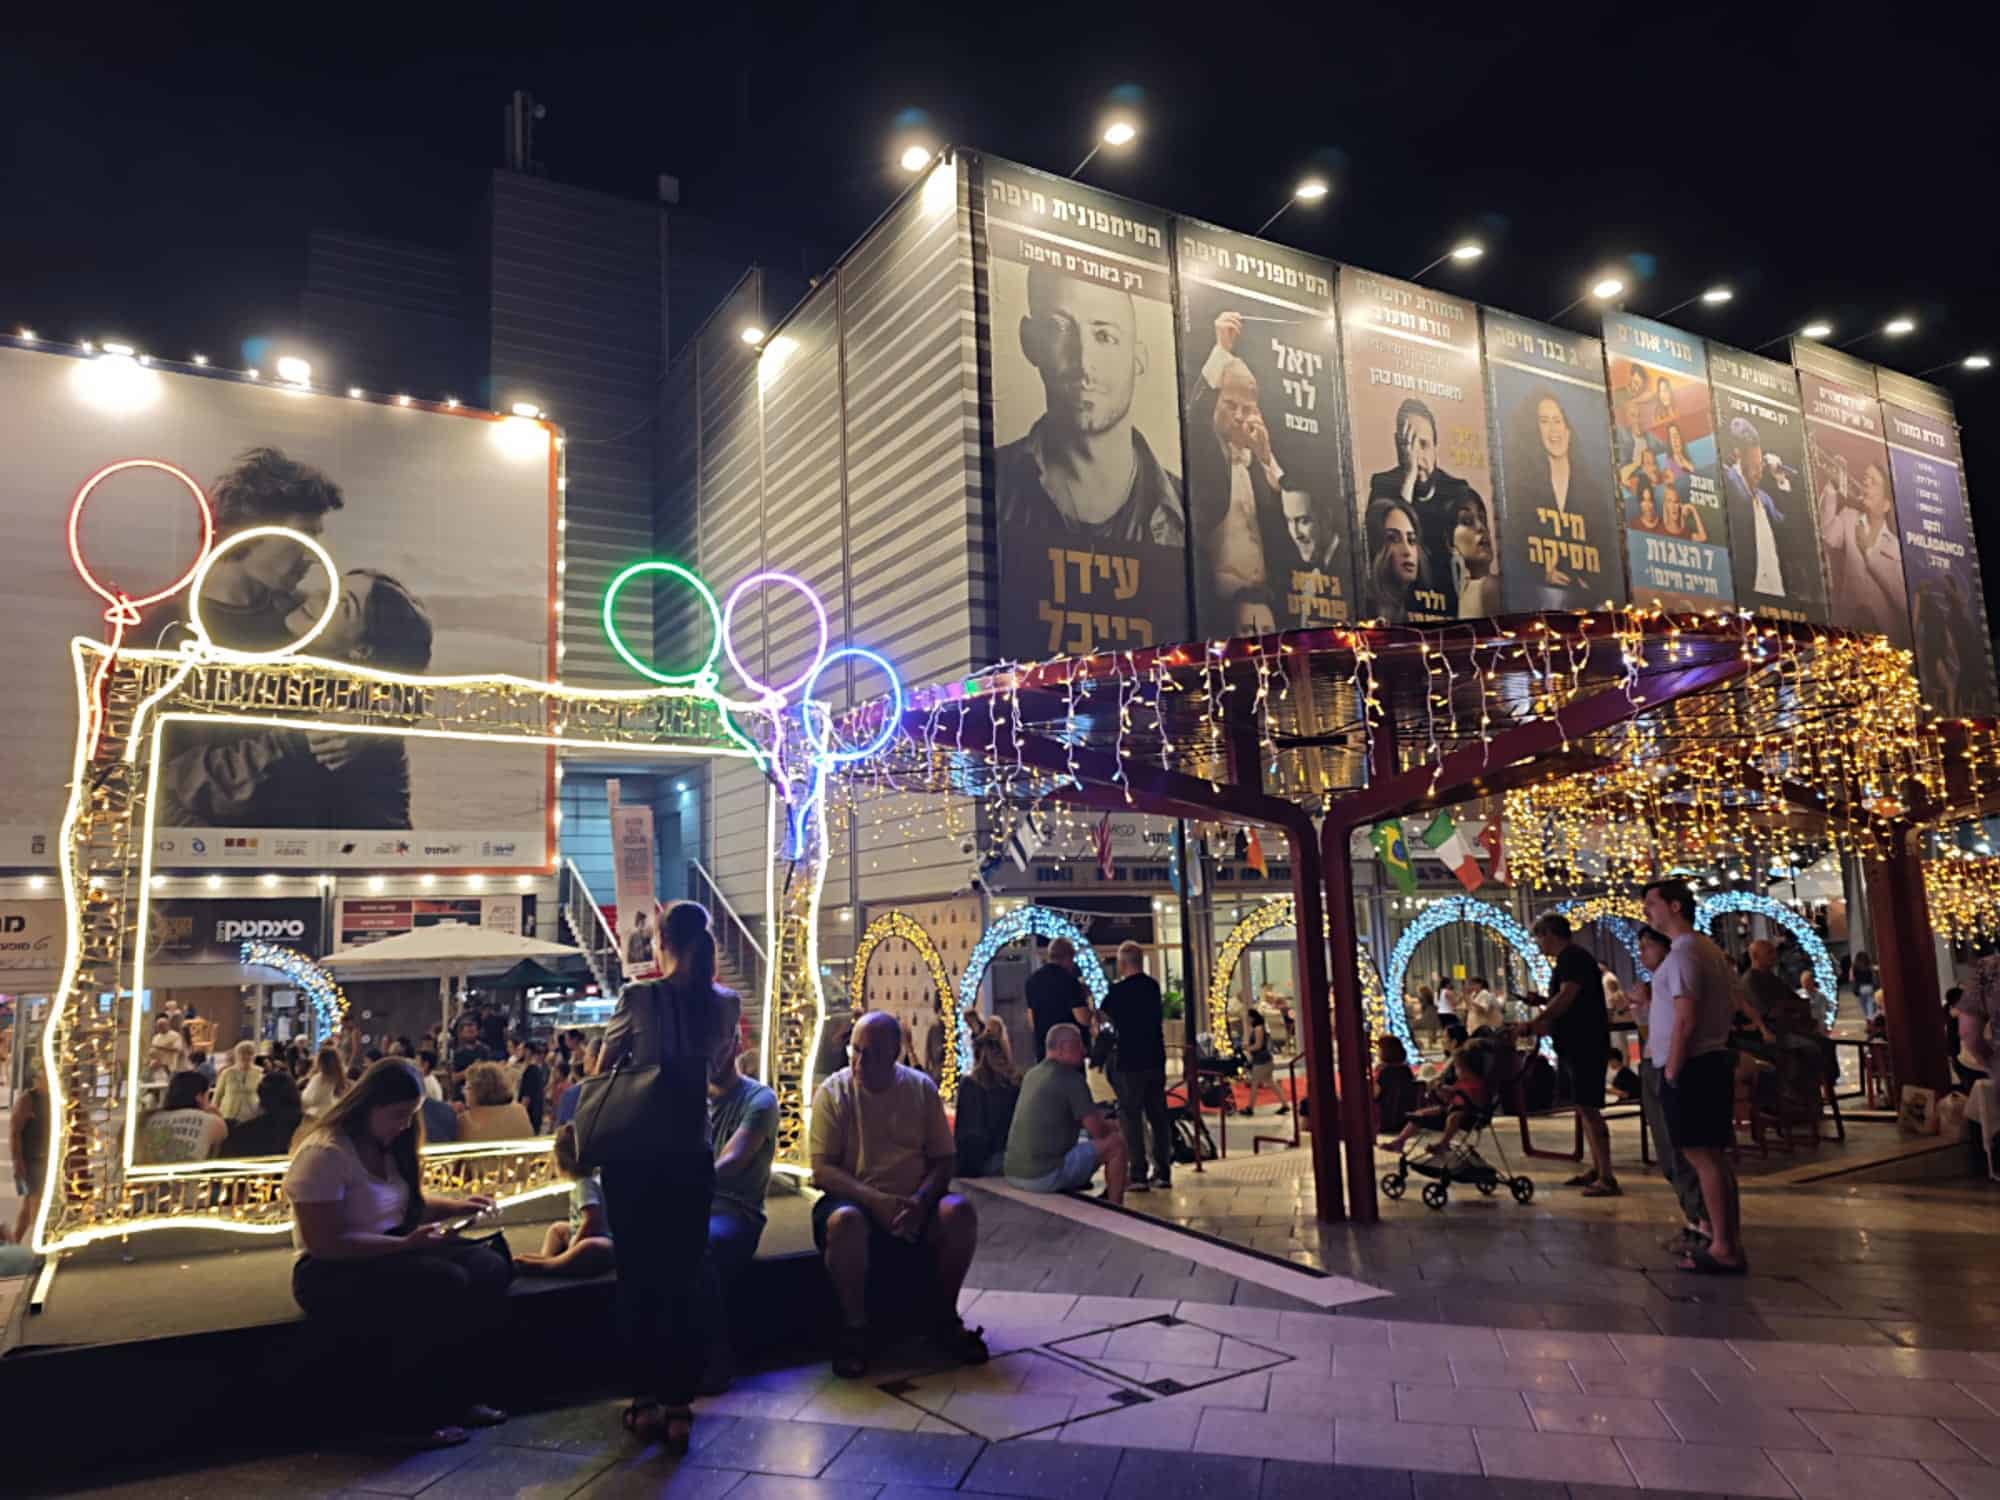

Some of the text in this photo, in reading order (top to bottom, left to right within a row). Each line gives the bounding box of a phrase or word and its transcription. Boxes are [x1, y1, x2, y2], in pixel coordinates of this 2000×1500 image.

[991, 178, 1161, 249] הסימפונית חיפה
[1019, 239, 1062, 267] חיפה!
[1184, 237, 1329, 297] הסימפונית חיפה
[1123, 272, 1143, 290] רק
[1272, 337, 1322, 377] יואל
[1283, 377, 1316, 410] לוי
[1370, 367, 1392, 385] כהן
[1536, 506, 1586, 543] מירי
[1528, 535, 1601, 583] מסיקה
[1646, 537, 1701, 570] הצגות
[1047, 547, 1140, 605] עידן
[1413, 589, 1447, 611] ולרי
[1039, 600, 1153, 654] רייכל
[224, 919, 305, 943] סינמטק
